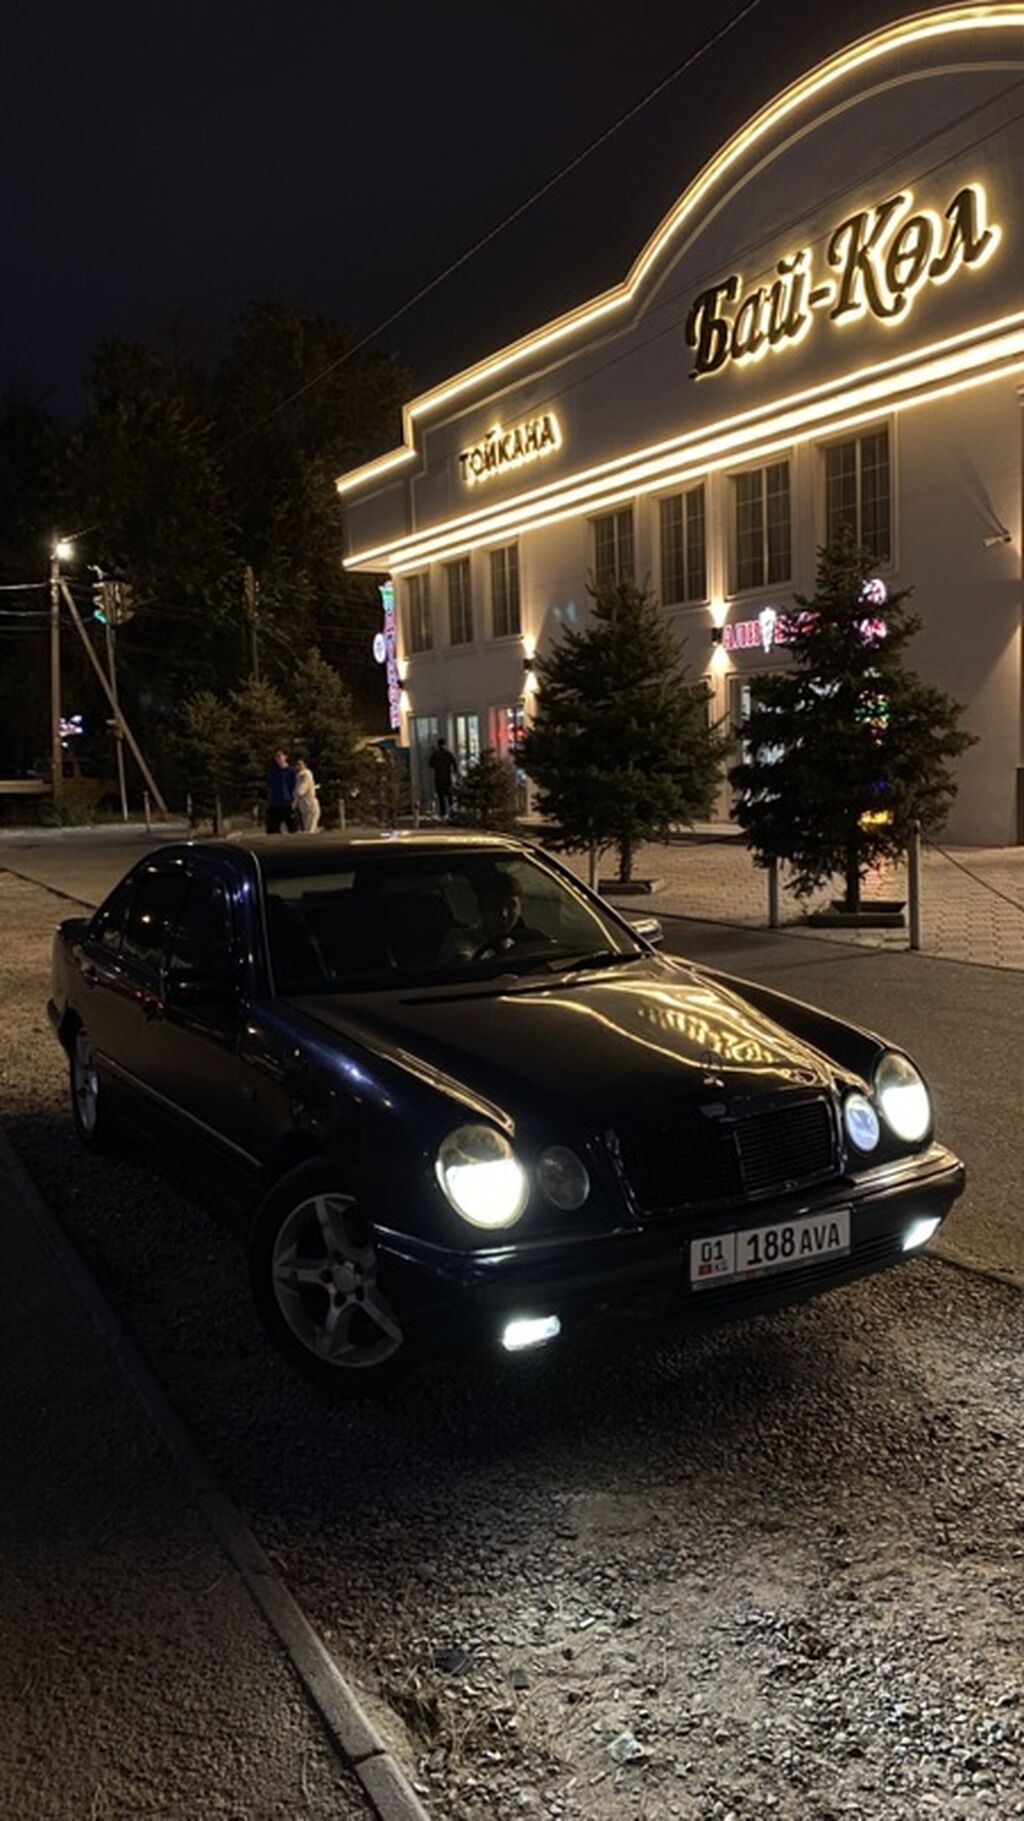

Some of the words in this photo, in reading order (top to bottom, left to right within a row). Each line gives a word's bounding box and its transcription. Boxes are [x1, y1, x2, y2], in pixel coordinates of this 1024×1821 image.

[685, 186, 996, 381] Бай-Көл
[458, 414, 559, 483] ТОЙКАНА
[701, 1239, 724, 1262] 01
